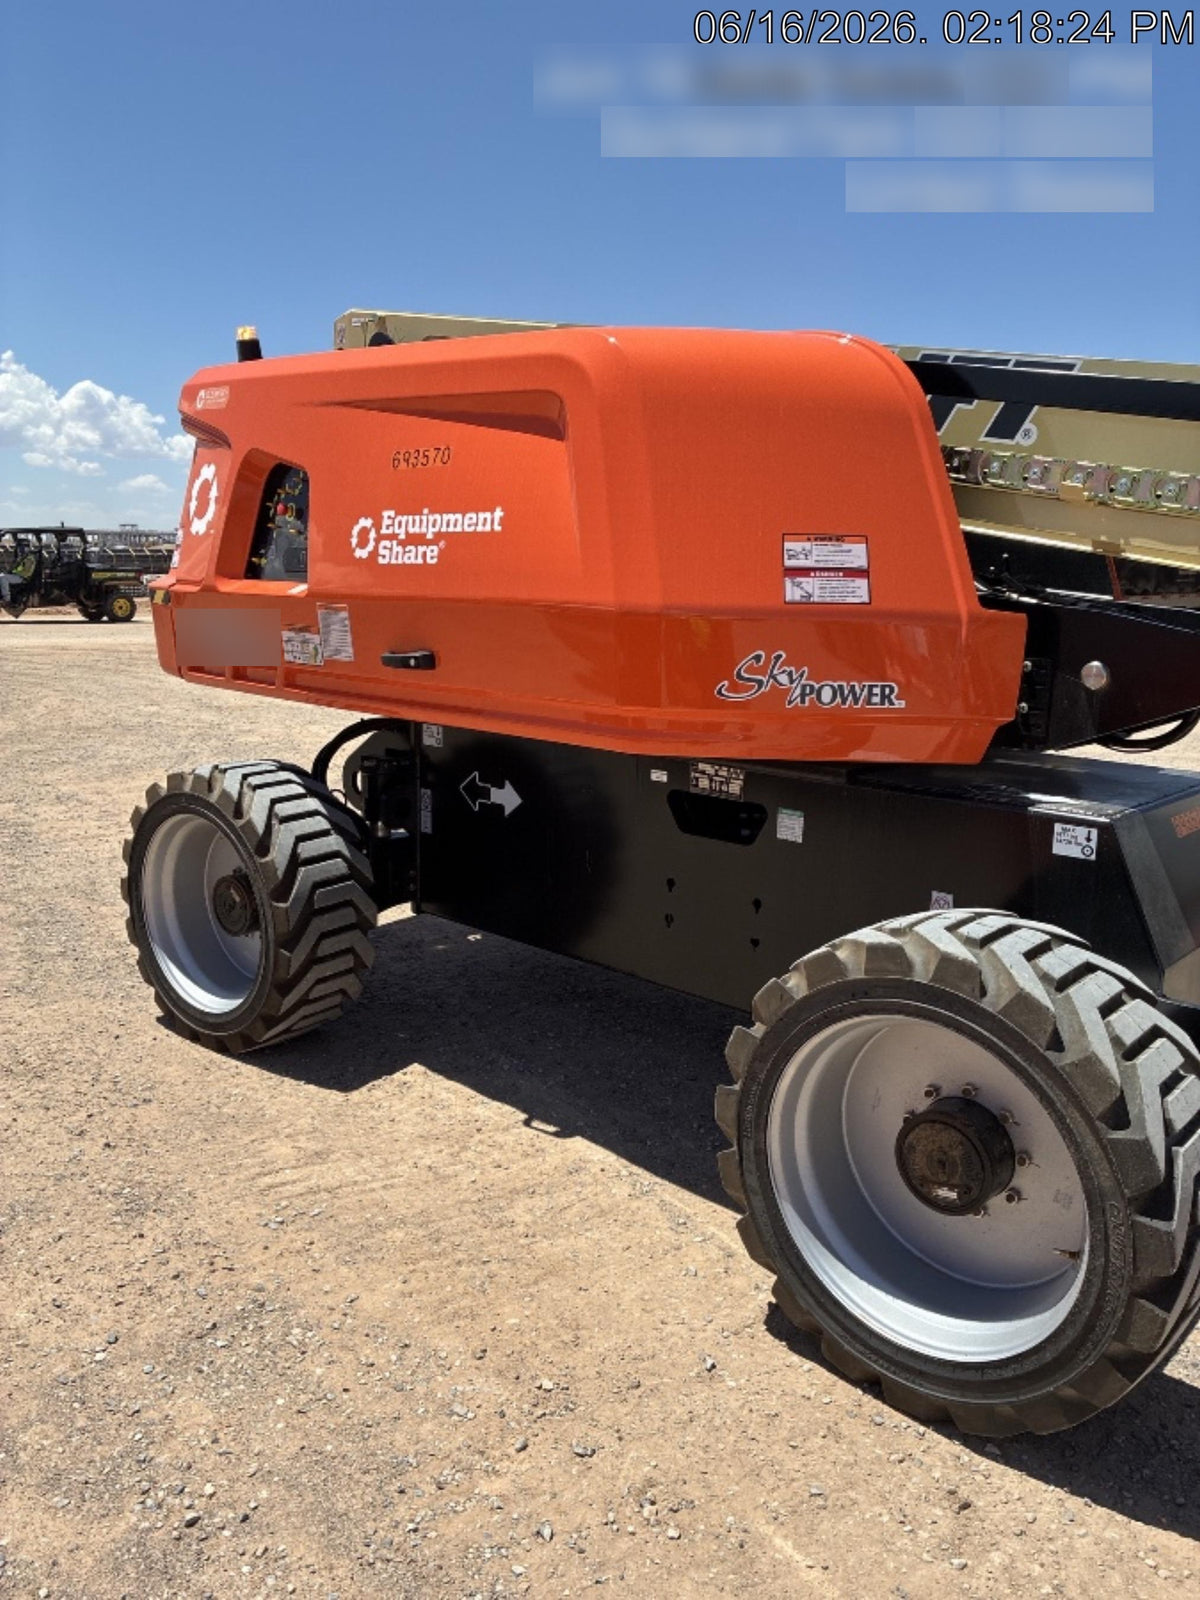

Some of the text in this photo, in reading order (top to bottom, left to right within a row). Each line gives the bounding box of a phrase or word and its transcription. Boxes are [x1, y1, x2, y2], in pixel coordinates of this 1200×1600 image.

[391, 446, 451, 470] 693570
[379, 505, 504, 539] Equipment
[377, 540, 440, 564] Share
